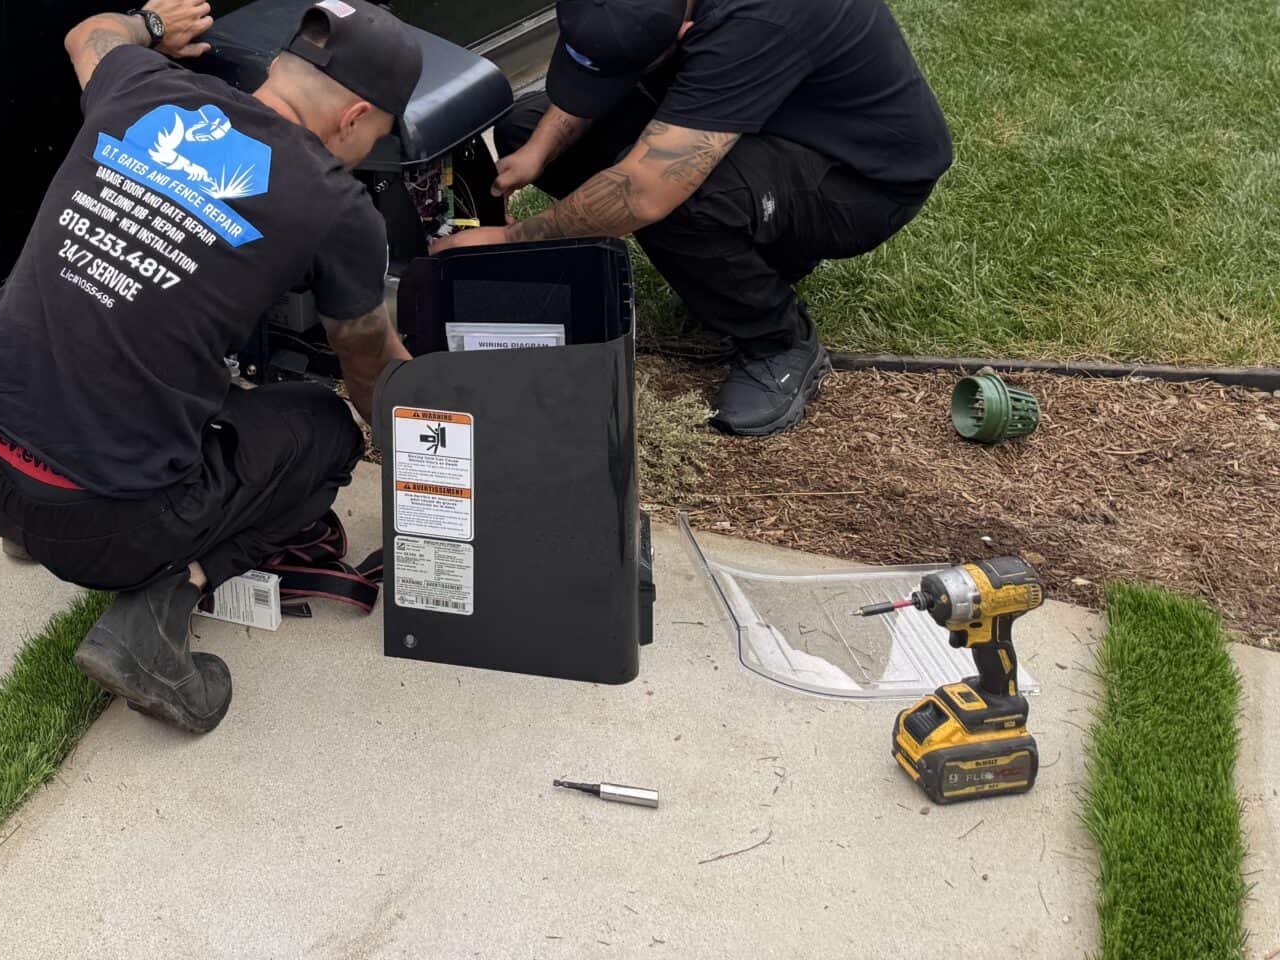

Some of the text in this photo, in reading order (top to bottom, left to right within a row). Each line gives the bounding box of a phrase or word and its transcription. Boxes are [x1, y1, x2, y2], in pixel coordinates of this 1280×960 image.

[99, 186, 135, 212] WELDING
[131, 204, 149, 220] JOB
[151, 216, 186, 244] REPAIR
[101, 144, 243, 238] D.T. GATES AND FENCE REPAIR
[122, 179, 146, 199] DOOR
[142, 191, 163, 209] AND
[160, 202, 186, 223] GATE
[182, 217, 217, 246] REPAIR
[58, 208, 182, 289] 818.253.4817
[71, 190, 118, 223] FABRICATION
[119, 217, 141, 236] NEW
[136, 227, 199, 274] INSTALLATION
[58, 239, 143, 302] 24/7 SERVICE
[422, 411, 453, 421] WARNING
[412, 482, 464, 496] AVERTISSEMENT
